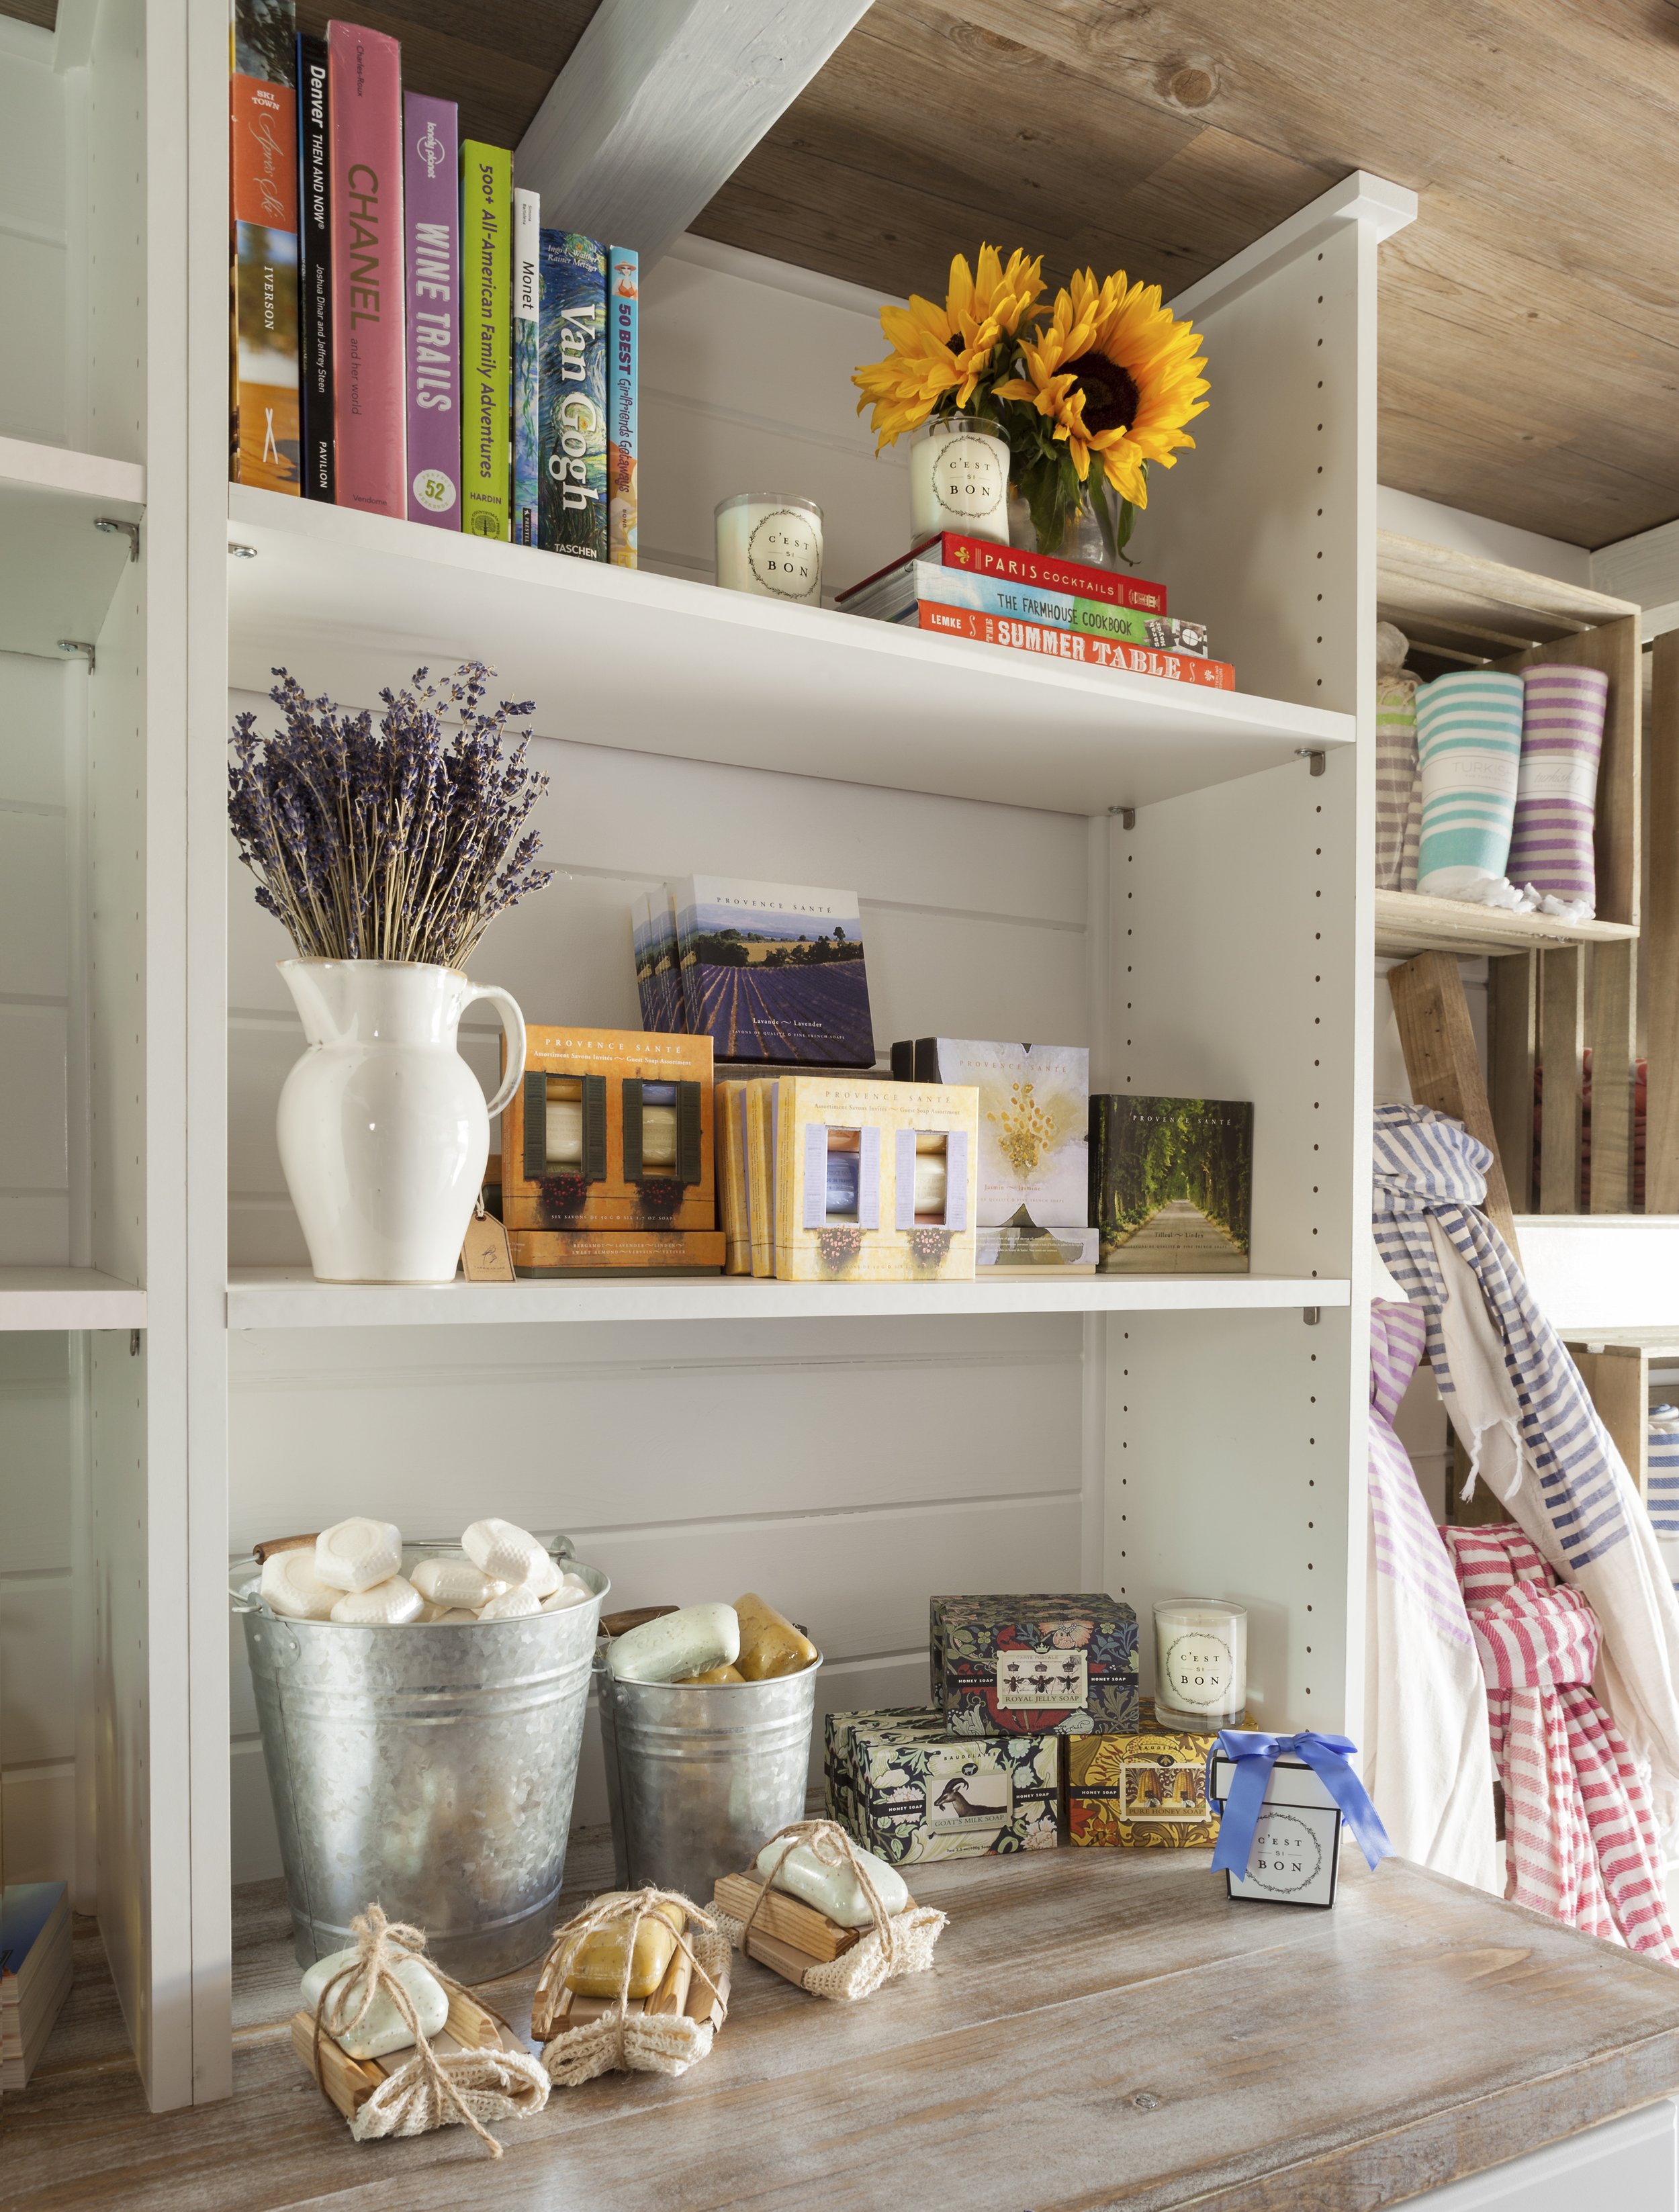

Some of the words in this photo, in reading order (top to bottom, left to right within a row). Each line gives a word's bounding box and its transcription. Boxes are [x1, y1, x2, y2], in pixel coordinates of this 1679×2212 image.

[356, 45, 366, 97] Charles-Roux
[251, 97, 281, 111] TOWN
[257, 89, 275, 101] SKI
[310, 65, 326, 128] Denver
[424, 122, 437, 149] lonely
[312, 134, 324, 165] THEN
[424, 149, 436, 179] planet
[313, 167, 324, 193] AND
[479, 164, 494, 205] 500+
[347, 163, 381, 331] CHANEL
[548, 244, 563, 256] Ingo
[573, 249, 598, 264] Walther
[414, 222, 451, 302] WINE
[482, 209, 498, 319] All-American
[548, 254, 572, 265] Rainer
[573, 258, 598, 273] Metzger
[316, 264, 324, 295] Joshua
[523, 261, 535, 310] Monet
[264, 266, 274, 330] IVERSON
[317, 296, 325, 320] Dinar
[618, 303, 632, 327] 50
[318, 321, 326, 337] and
[316, 338, 327, 367] Jeffrey
[350, 338, 361, 360] and
[476, 324, 497, 379] Family
[560, 304, 596, 382] Van
[618, 330, 632, 375] BEST
[351, 364, 362, 382] her
[415, 312, 452, 412] TRAILS
[318, 369, 326, 394] Steen
[351, 384, 362, 416] world
[617, 379, 634, 438] Girlfriends
[479, 383, 497, 479] Adventures
[549, 391, 600, 511] Gogh
[319, 441, 328, 489] PAVILION
[617, 440, 634, 494] Getaways
[949, 457, 991, 471] C'EST
[352, 494, 388, 507] Vendome
[424, 479, 446, 502] 52
[469, 491, 502, 505] HARDIN
[950, 485, 991, 497] BON
[554, 543, 598, 559] TASCHEN
[768, 532, 811, 551] C'EST
[767, 560, 809, 579] BON
[985, 554, 1038, 579] PARIS
[1042, 571, 1115, 596] COCKTAILS
[997, 592, 1018, 611] THE
[1022, 598, 1079, 626] FARMHOUSE
[1082, 611, 1132, 636] COOKBOOK
[931, 612, 962, 630] LEMKE
[985, 618, 994, 643] THE
[997, 620, 1086, 662] SUMMER
[1092, 641, 1181, 680] TABLE
[1149, 622, 1160, 648] Sarah
[1156, 621, 1167, 647] Mayor
[717, 896, 784, 909] PROVENCE
[793, 903, 833, 914] SANTÉ
[753, 1017, 779, 1025] Lavande
[533, 1050, 570, 1059] Assortiment
[592, 1053, 613, 1061] Invités
[627, 1056, 643, 1064] Guest
[644, 1057, 659, 1065] Soap
[660, 1057, 692, 1066] Assortment
[545, 1039, 625, 1050] PROVENCE
[635, 1044, 682, 1054] SANTÉ
[960, 1060, 1022, 1070] PROVENCE
[825, 1091, 899, 1101] PROVENCE
[917, 1107, 929, 1115] Soap
[1132, 1114, 1190, 1123] PROVENCE
[1197, 1117, 1232, 1125] SANTÉ
[1180, 1651, 1219, 1662] C'EST
[1181, 1675, 1220, 1686] BON
[944, 1751, 997, 1761] BAUDELAIRE
[934, 1817, 962, 1827] GOAT'S
[963, 1816, 983, 1825] MILK
[984, 1814, 1005, 1823] SOAP
[1258, 1833, 1303, 1847] C'EST
[1258, 1859, 1303, 1873] BON
